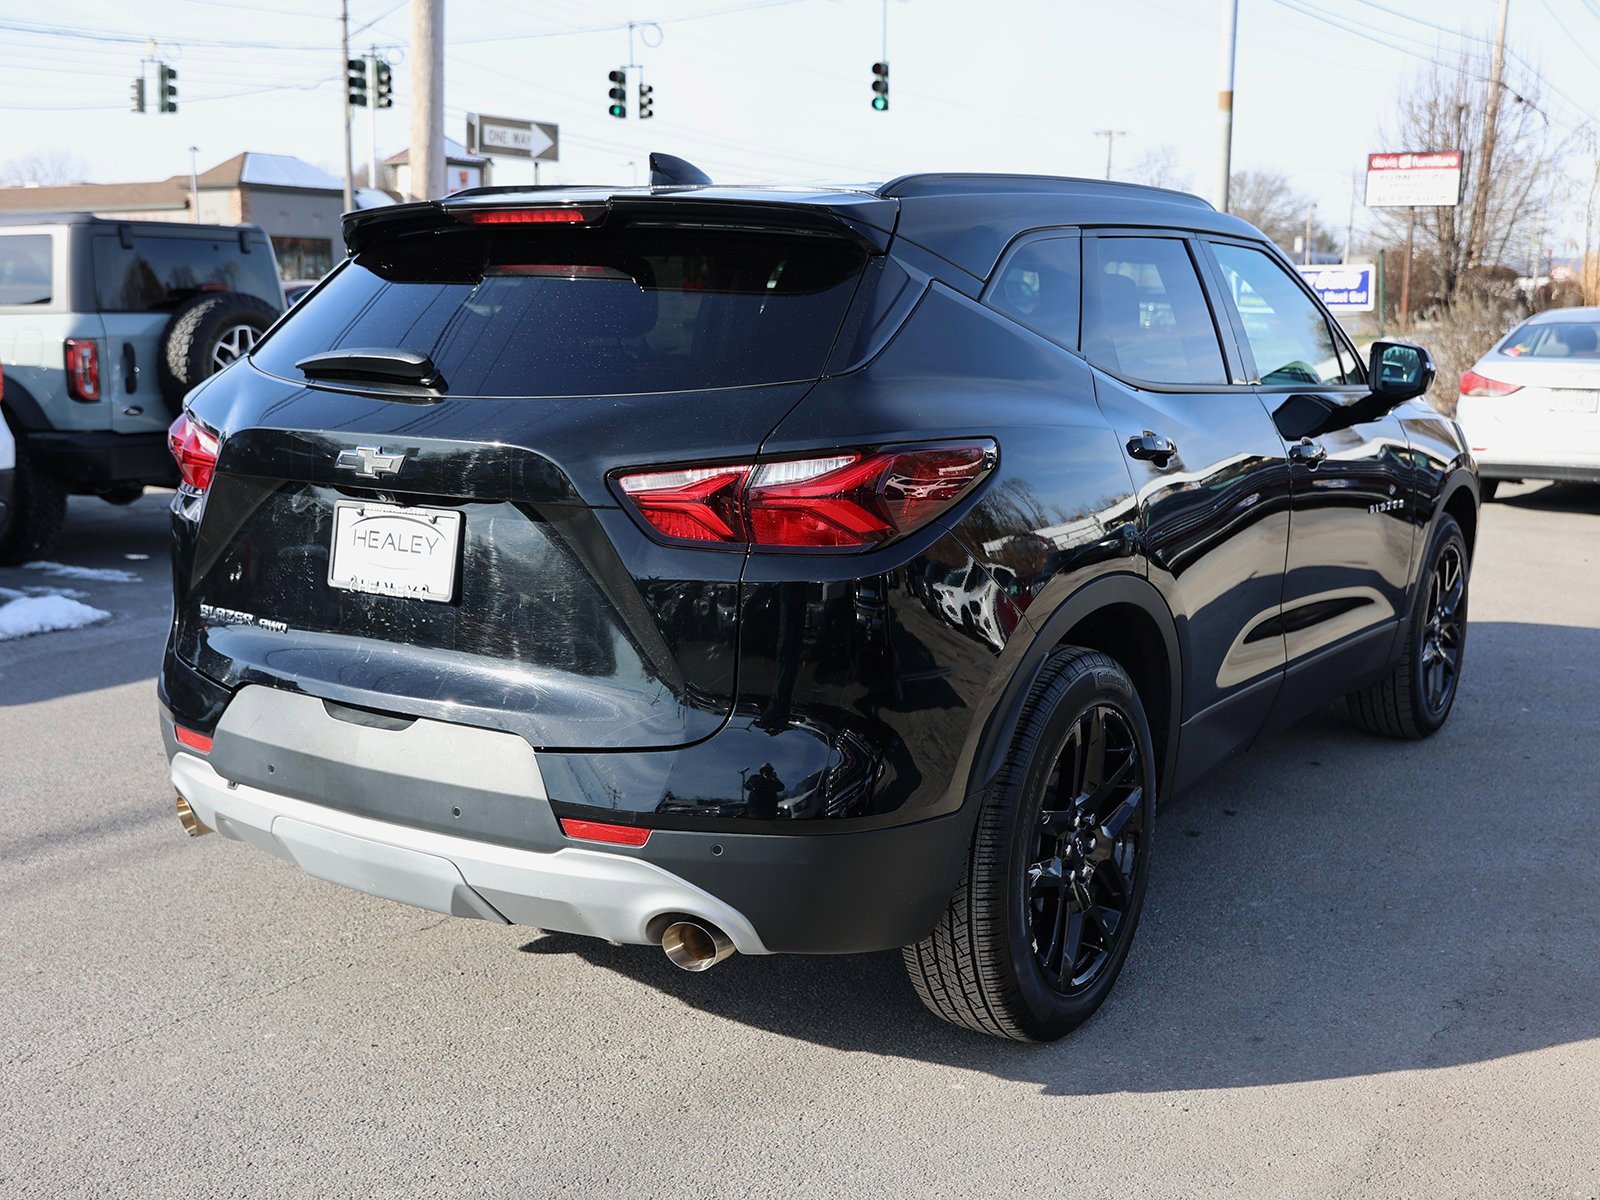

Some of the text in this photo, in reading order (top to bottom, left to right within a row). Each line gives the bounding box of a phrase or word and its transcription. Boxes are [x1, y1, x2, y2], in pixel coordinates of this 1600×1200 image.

[487, 128, 533, 147] ONE WAY
[353, 528, 440, 556] HEALEY
[199, 603, 289, 637] BLAZER AWD
